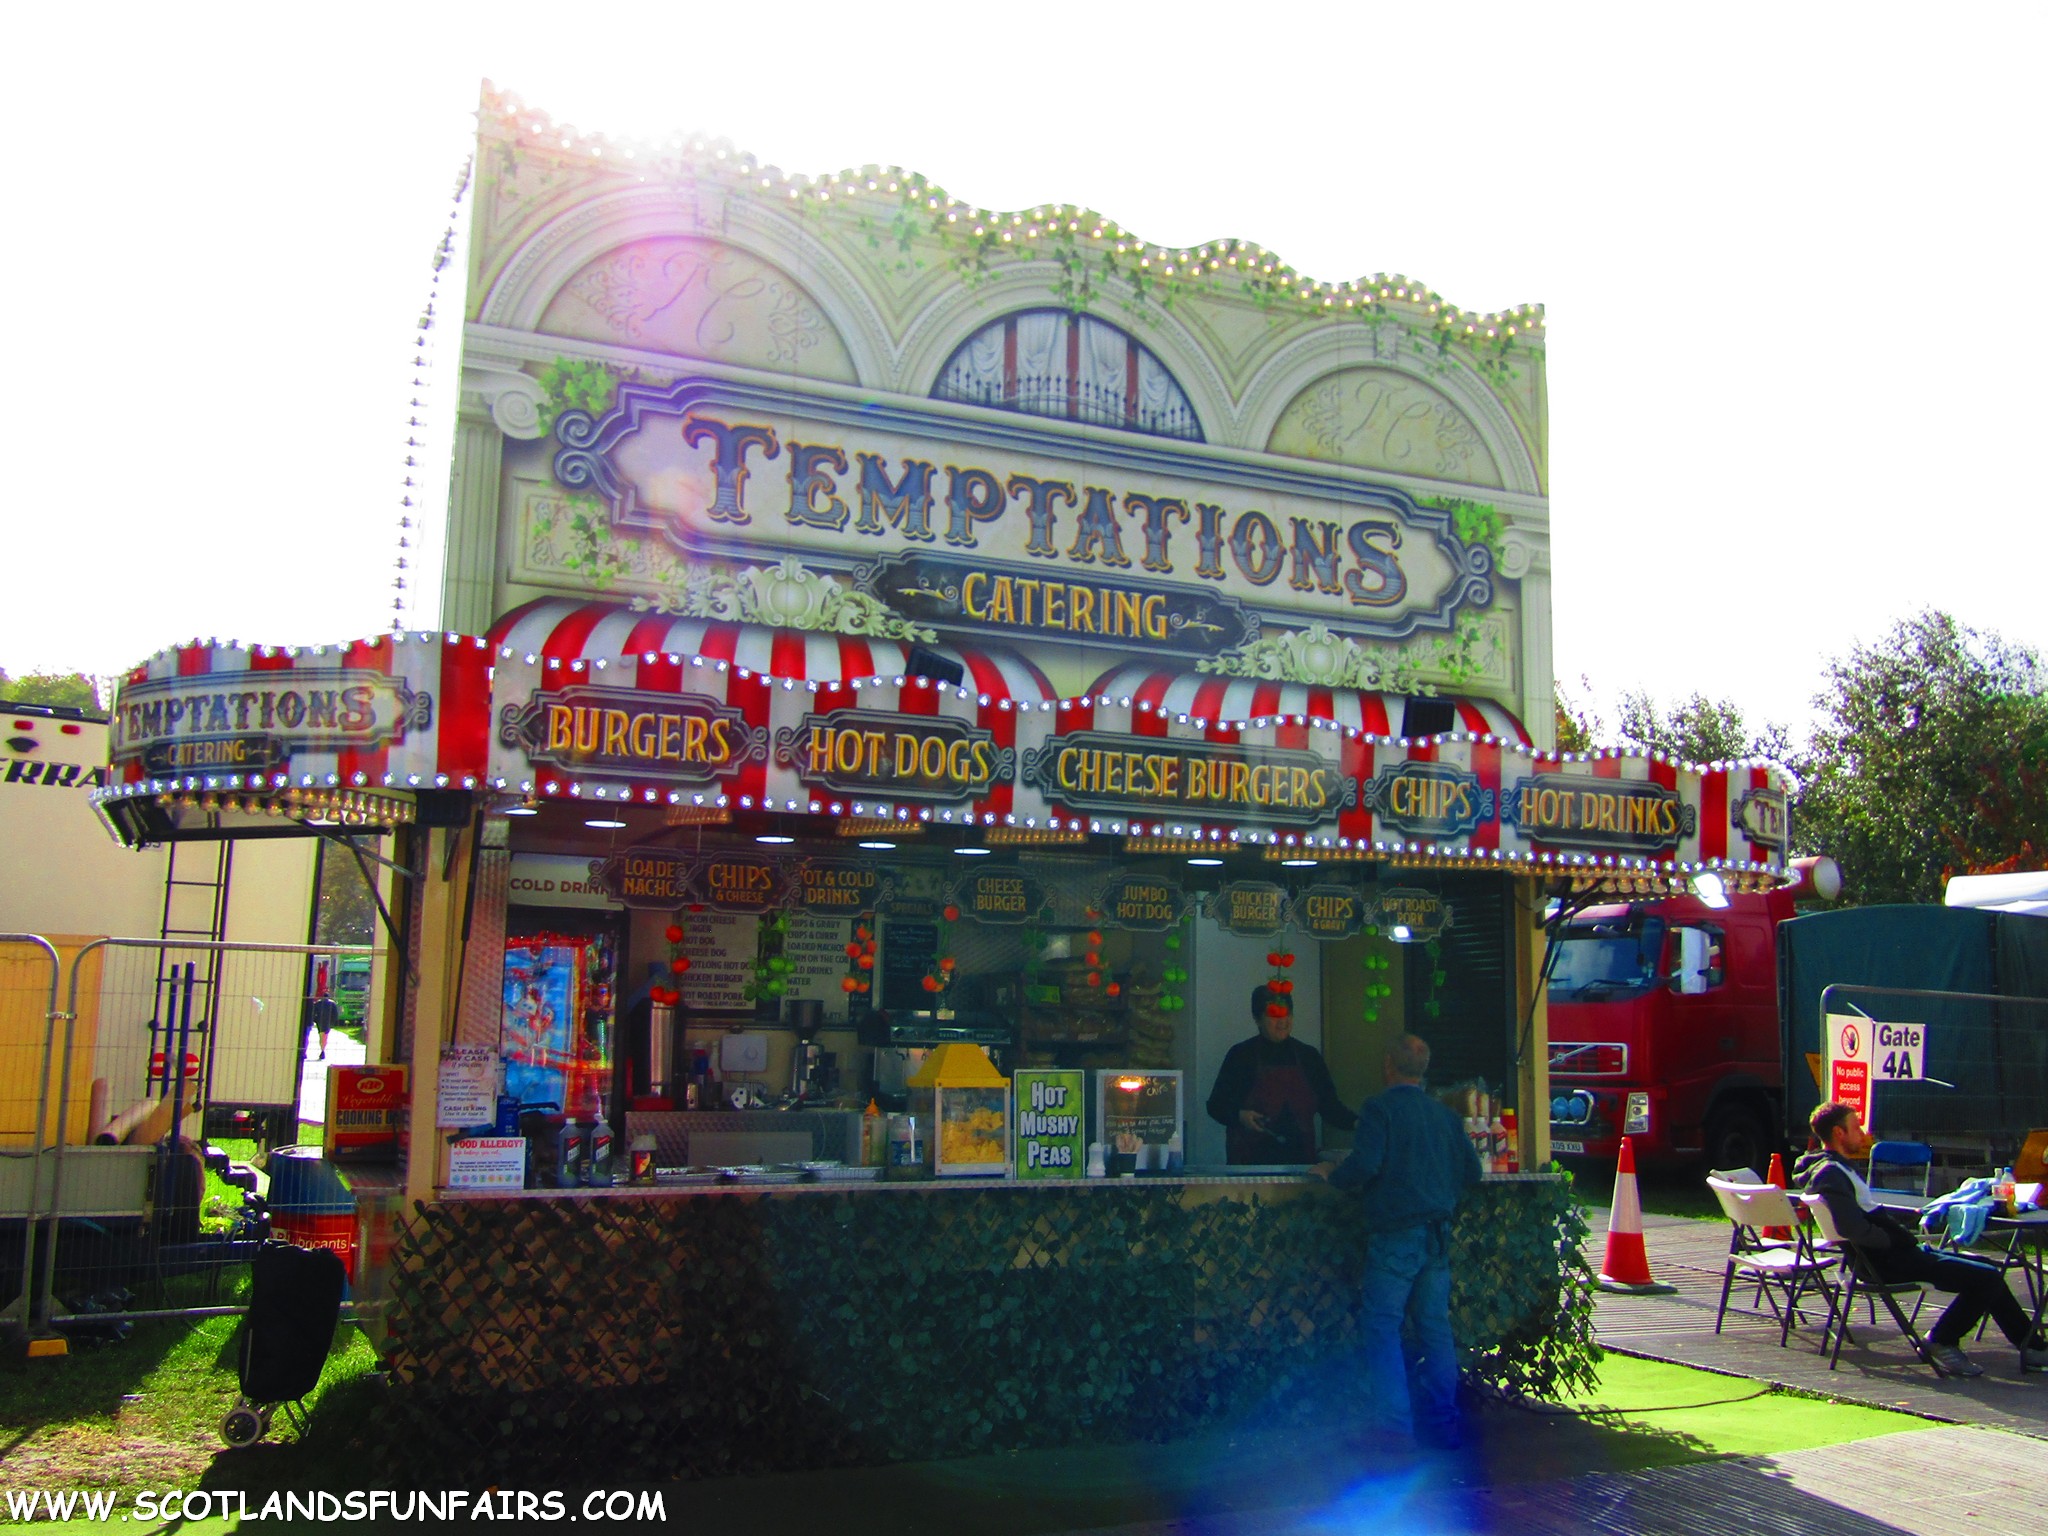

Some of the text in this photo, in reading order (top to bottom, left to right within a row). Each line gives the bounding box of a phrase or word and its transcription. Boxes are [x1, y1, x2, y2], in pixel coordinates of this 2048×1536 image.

[682, 413, 1408, 606] TEMPTATIONS
[961, 572, 1169, 641] CATERING
[117, 686, 377, 748] TEMPTATIONS
[545, 705, 732, 763] BURGERS
[167, 740, 246, 768] CATERING
[807, 728, 991, 782] HOT DOGS
[0, 758, 107, 788] RRA
[1057, 748, 1326, 808] CHEESE BURGERS
[1390, 776, 1471, 820] CHIPS
[1518, 787, 1678, 835] HOT DRINKS
[1754, 799, 1784, 833] TE
[624, 858, 677, 879] LOADE
[708, 863, 772, 891] CHIPS
[825, 870, 835, 887] &
[838, 871, 875, 888] COLD
[511, 878, 609, 896] COLD DRINK
[716, 890, 765, 904] & CHEESE
[807, 887, 860, 905] DRINKS
[977, 877, 1025, 895] CHEESE
[1122, 884, 1169, 903] JUMBO
[976, 894, 1027, 912] BURGER
[1232, 891, 1278, 907] CHICKEN
[1307, 896, 1354, 919] CHIPS
[1382, 897, 1437, 913] HOT ROAST
[1116, 902, 1173, 921] HOT DOG
[1233, 905, 1277, 921] BURGER
[1397, 912, 1425, 926] PORK
[1313, 919, 1347, 931] & GRAVY
[1879, 1024, 1920, 1048] Gate
[1836, 1066, 1864, 1078] No public
[1882, 1051, 1914, 1079] 4A
[1031, 1081, 1068, 1113] HOT
[1839, 1082, 1861, 1092] access
[336, 1110, 382, 1125] COOKING
[1020, 1110, 1079, 1138] MUSHY
[454, 1139, 524, 1149] FOOD ALLERGY?
[1027, 1140, 1072, 1168] PEAS
